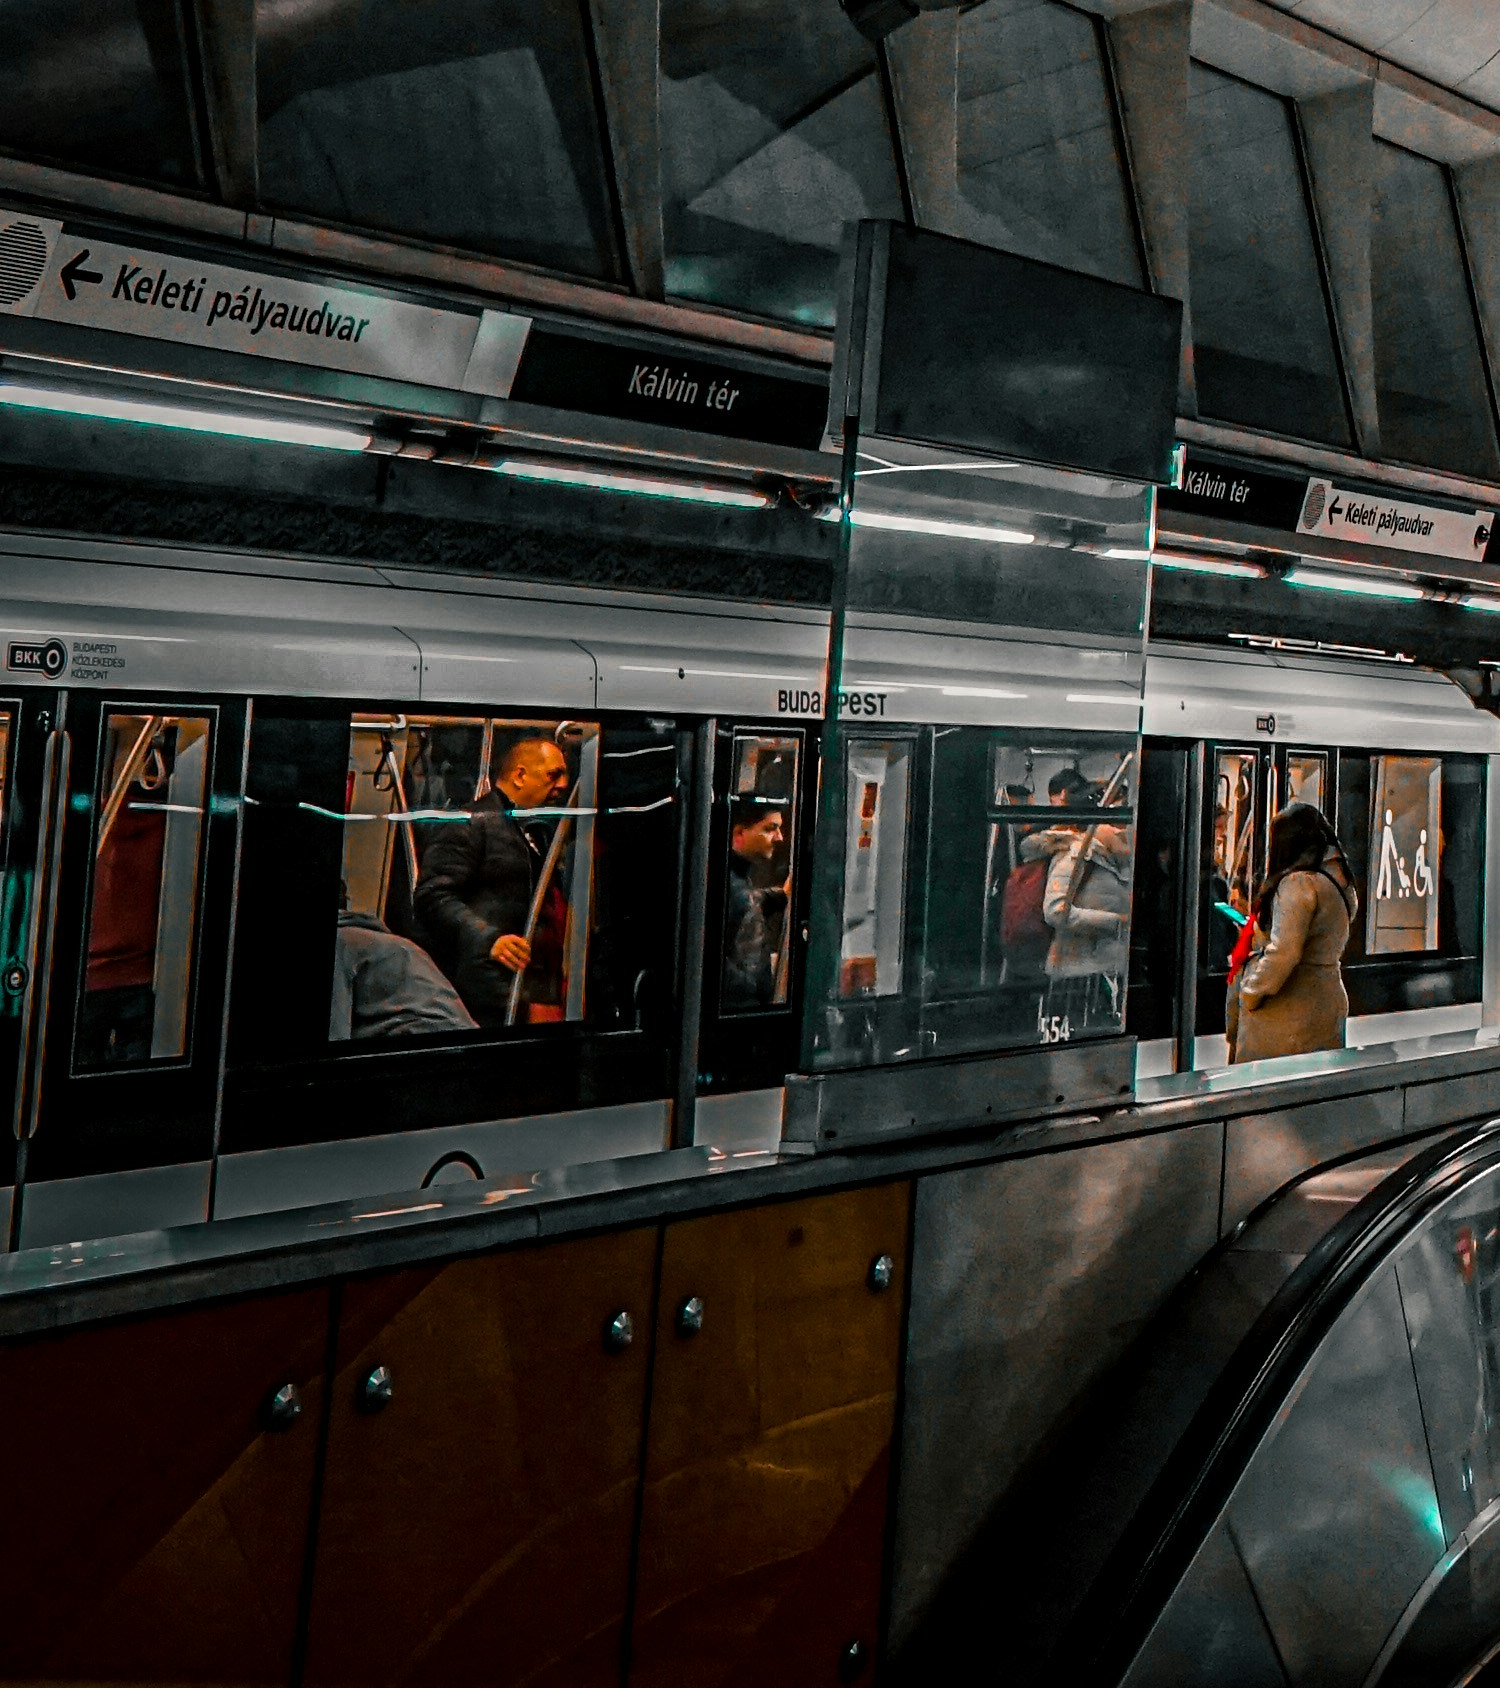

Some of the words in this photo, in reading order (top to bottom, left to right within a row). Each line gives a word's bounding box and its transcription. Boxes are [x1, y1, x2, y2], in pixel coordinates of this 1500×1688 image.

[112, 262, 204, 313] Keleti
[206, 288, 369, 346] pályaudvar
[628, 364, 698, 404] Kálvin
[704, 378, 740, 412] tér
[1185, 471, 1226, 499] Kálvin
[1230, 480, 1250, 503] tér
[1344, 501, 1376, 527] Keleti
[1376, 505, 1435, 537] pályaudvar
[15, 650, 41, 664] BKK
